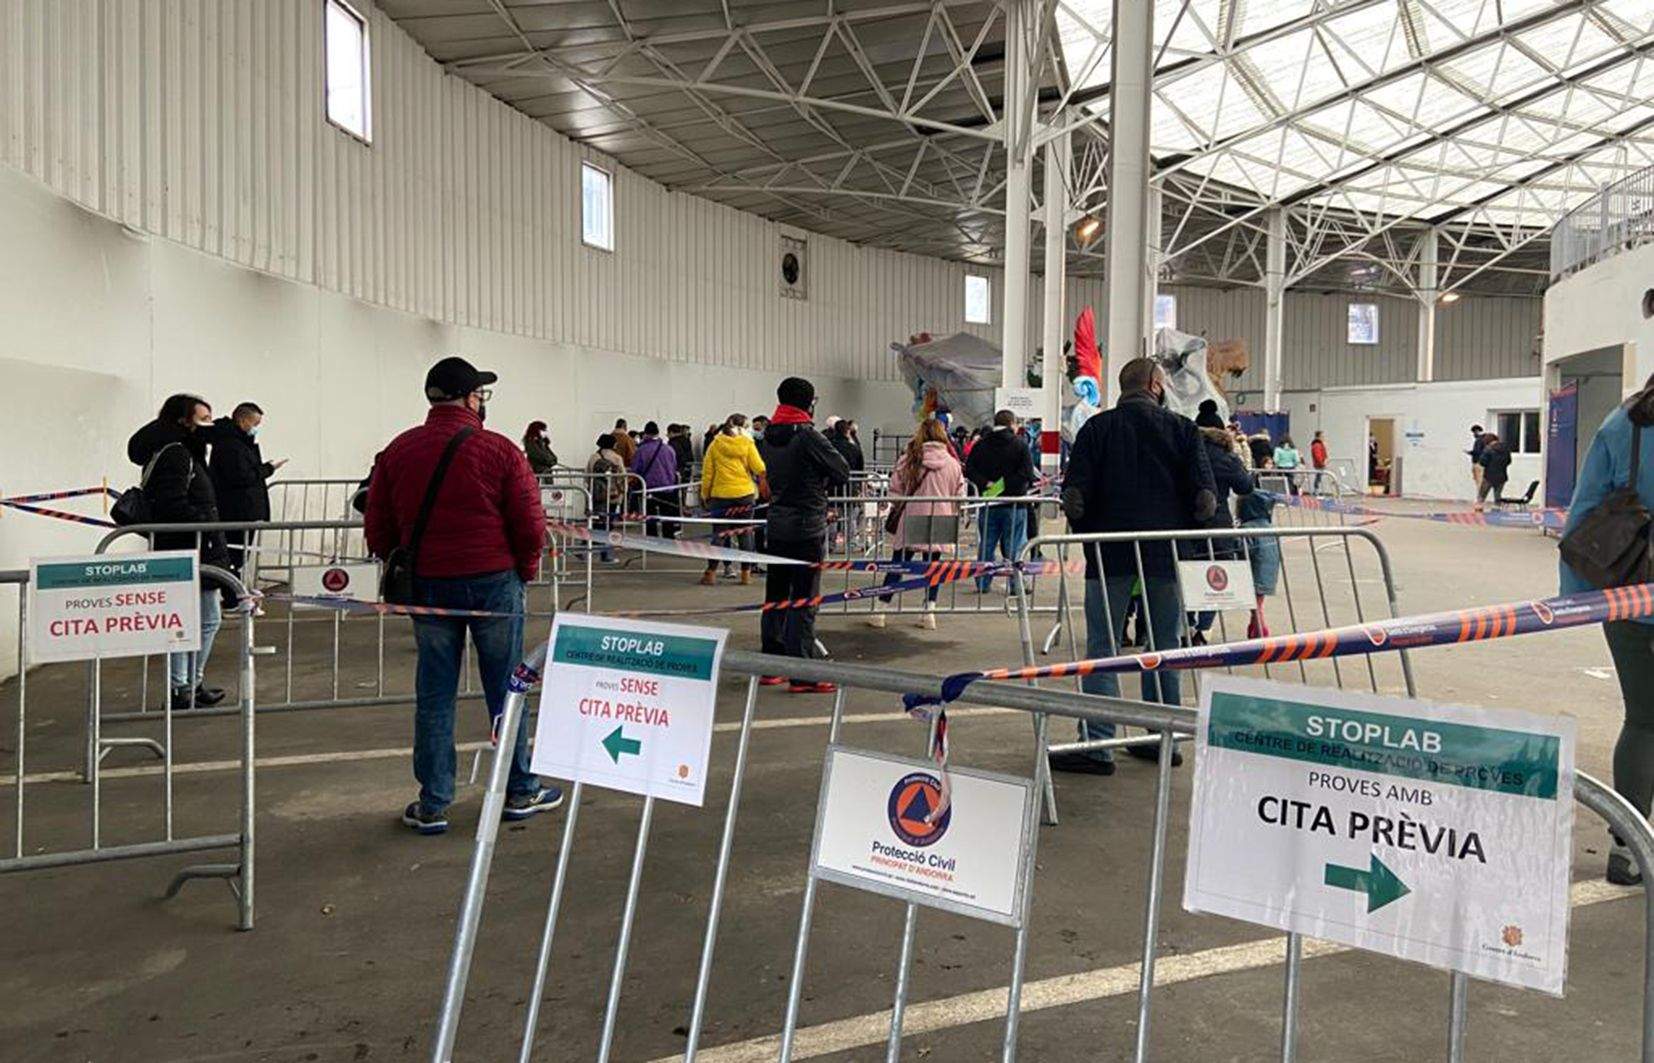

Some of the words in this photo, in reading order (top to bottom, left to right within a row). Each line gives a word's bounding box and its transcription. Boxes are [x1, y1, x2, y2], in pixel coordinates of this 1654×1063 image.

[85, 564, 147, 576] STOPLAB
[65, 597, 112, 609] PROVES
[115, 591, 166, 606] SENSE
[50, 619, 98, 637] CITA
[105, 612, 182, 633] PRÈVIA
[601, 636, 665, 655] STOPLAB
[620, 678, 658, 696] SENSE
[579, 699, 611, 720] CITA
[615, 700, 669, 726] PRÈVIA
[1306, 716, 1442, 753] STOPLAB
[1234, 731, 1293, 751] CENTRE
[1296, 740, 1317, 753] DE
[1427, 760, 1453, 774] DE
[1455, 764, 1525, 786] PROVES
[1308, 771, 1381, 798] PROVES
[1385, 784, 1433, 806] AMB
[1257, 796, 1336, 835] CITA
[1349, 812, 1487, 863] PRÈVIA
[872, 841, 925, 864] Protecció
[928, 854, 956, 871] Civil
